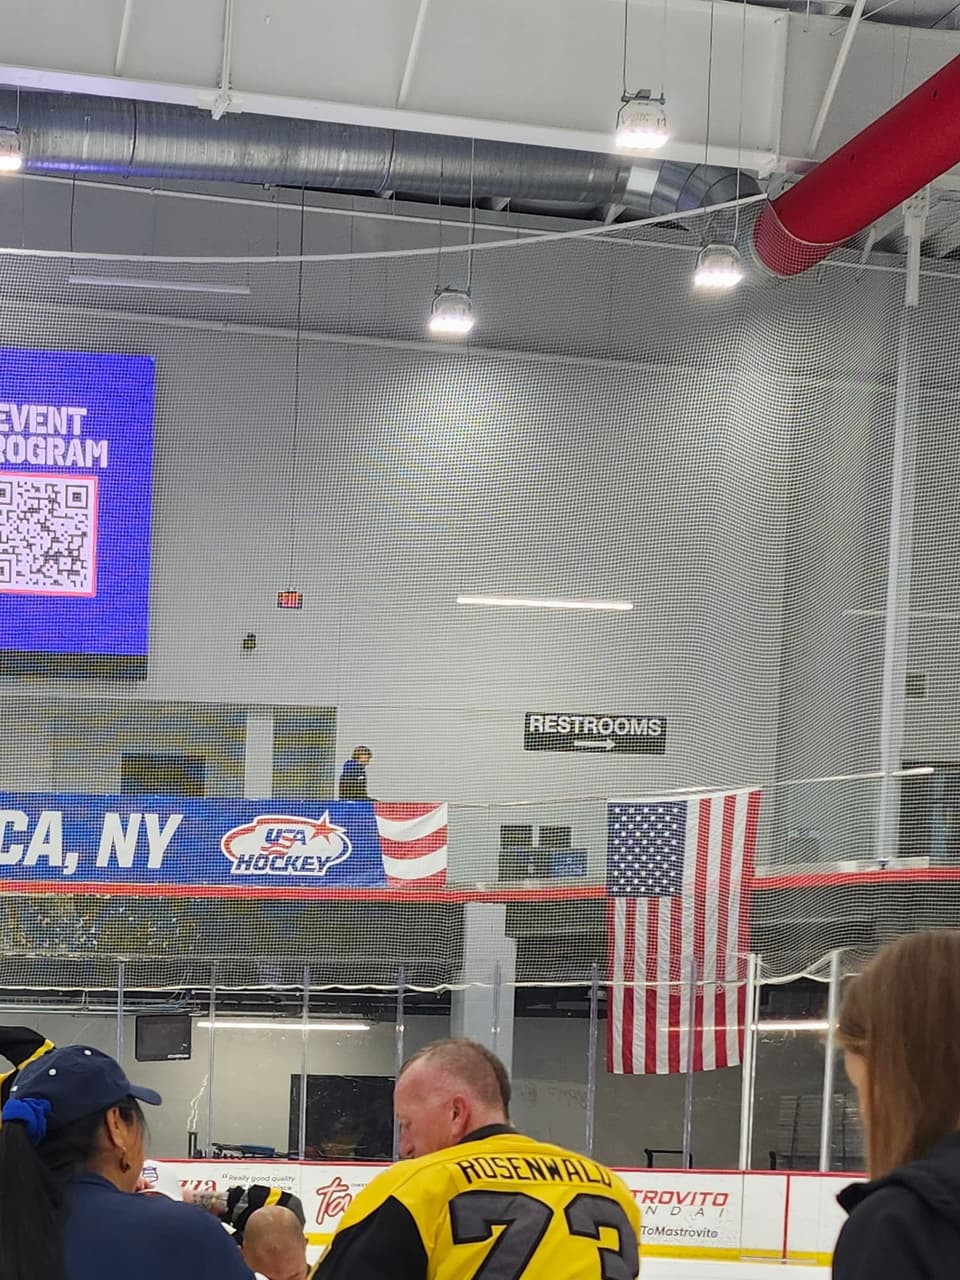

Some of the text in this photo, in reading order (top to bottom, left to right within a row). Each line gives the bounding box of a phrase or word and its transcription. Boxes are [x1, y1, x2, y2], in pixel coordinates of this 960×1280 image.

[529, 715, 663, 736] RESTROOMS
[94, 811, 184, 870] NY
[264, 828, 307, 846] USA
[234, 853, 332, 873] HOCKEY
[631, 1189, 729, 1207] TROVITO
[645, 1205, 725, 1218] NDAI
